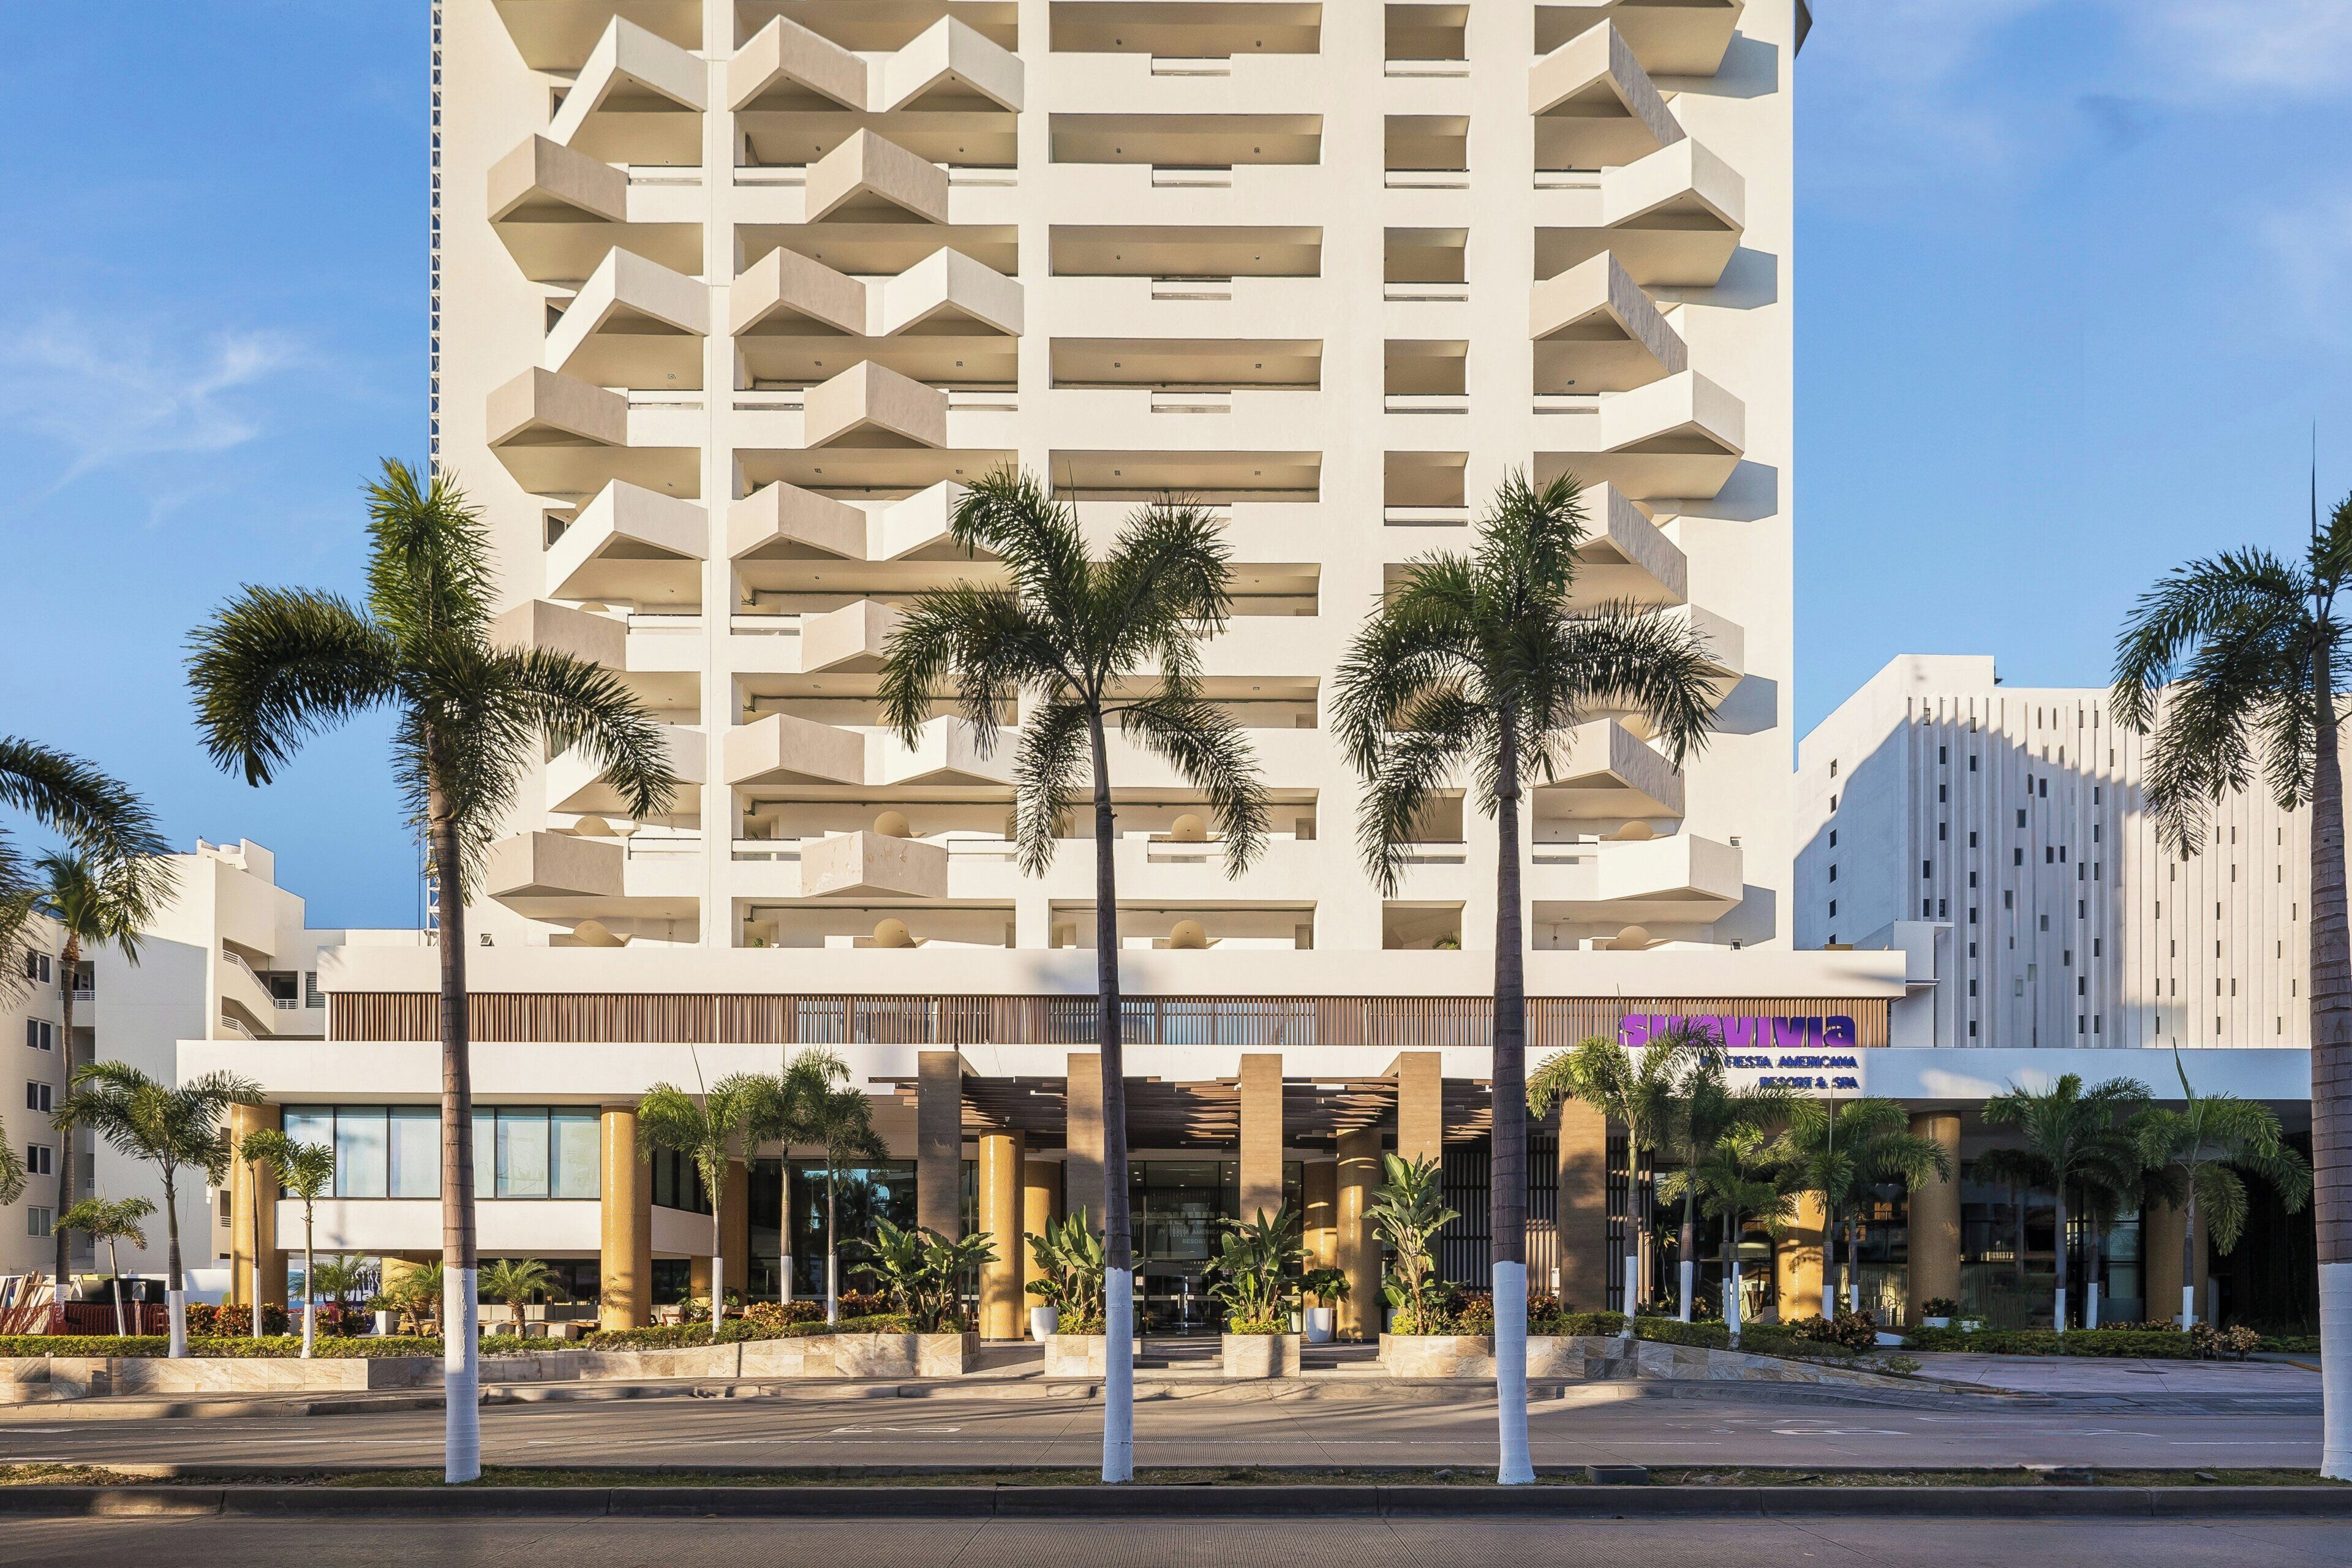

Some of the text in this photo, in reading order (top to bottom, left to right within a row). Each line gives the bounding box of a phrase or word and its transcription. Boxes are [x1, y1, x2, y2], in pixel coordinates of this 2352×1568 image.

[1724, 1055, 1773, 1068] FIESTA
[1777, 1055, 1858, 1068] AMERICANA
[1759, 1076, 1859, 1089] RESORT & SPA
